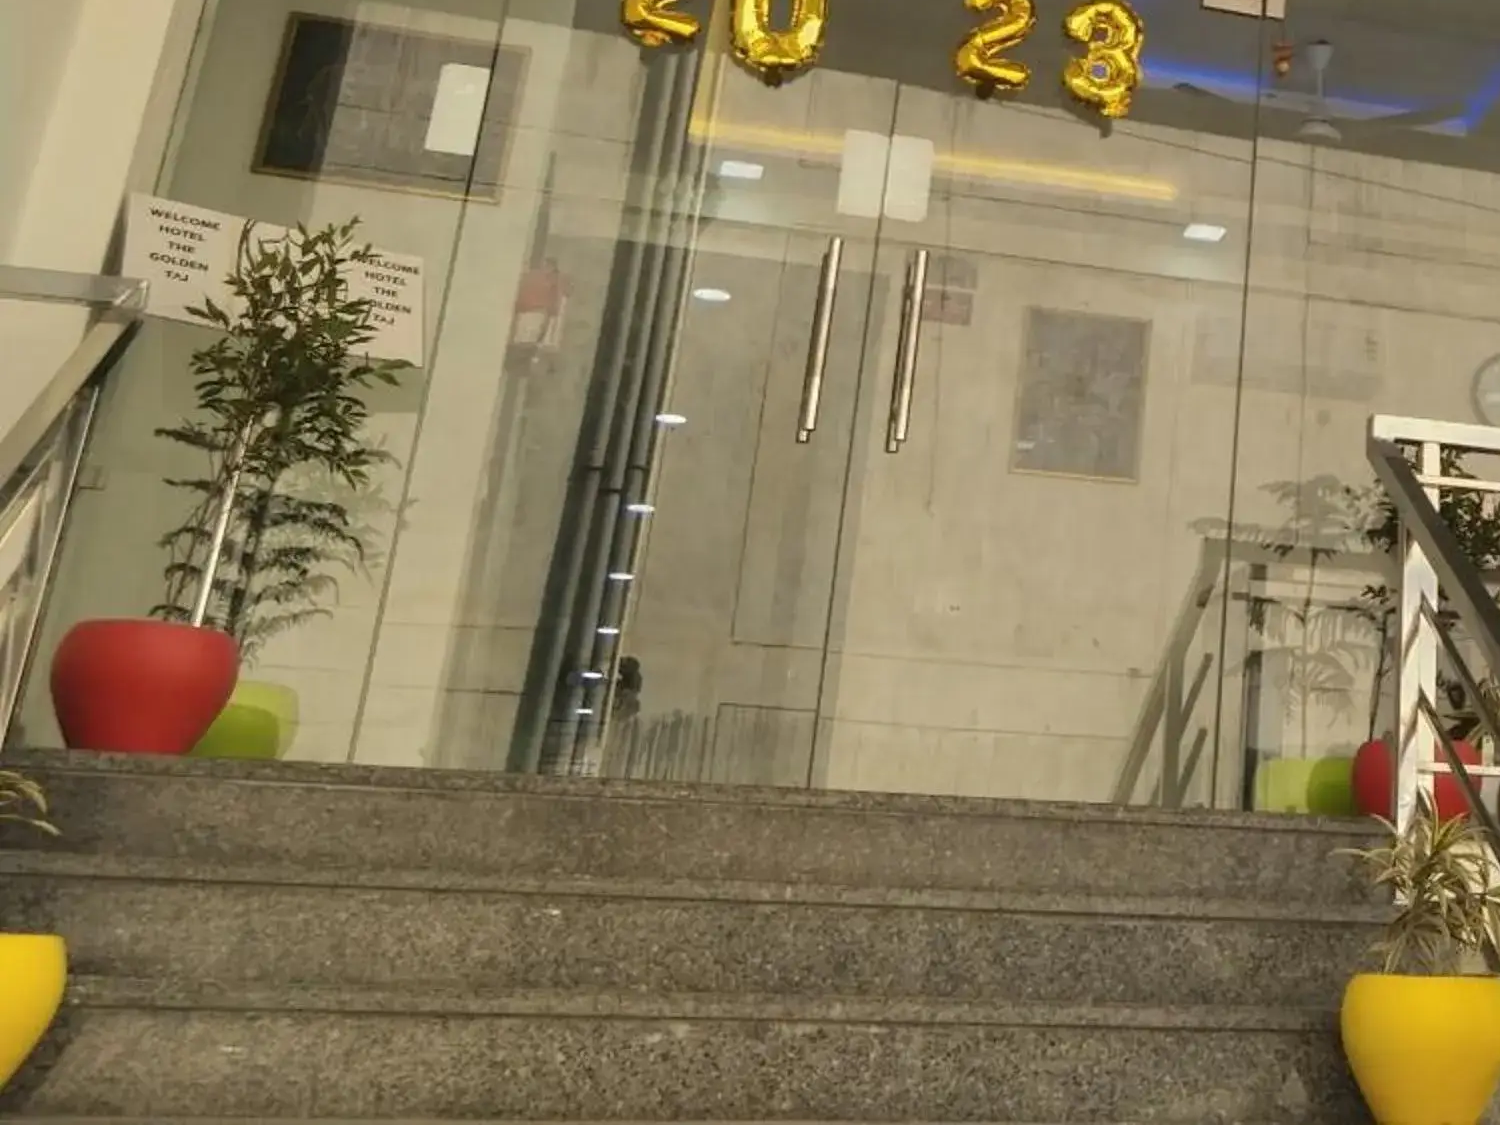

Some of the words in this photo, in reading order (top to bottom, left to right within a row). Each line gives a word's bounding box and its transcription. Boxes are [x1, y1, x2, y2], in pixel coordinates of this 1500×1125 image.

[149, 206, 221, 230] WELCOME
[159, 225, 206, 242] HOTEL
[168, 241, 196, 254] THE
[149, 252, 209, 271] GOLDEN
[164, 270, 189, 282] TAJ
[365, 271, 406, 286] HOTEL
[374, 286, 397, 297] THE
[361, 299, 411, 314] OLDEN
